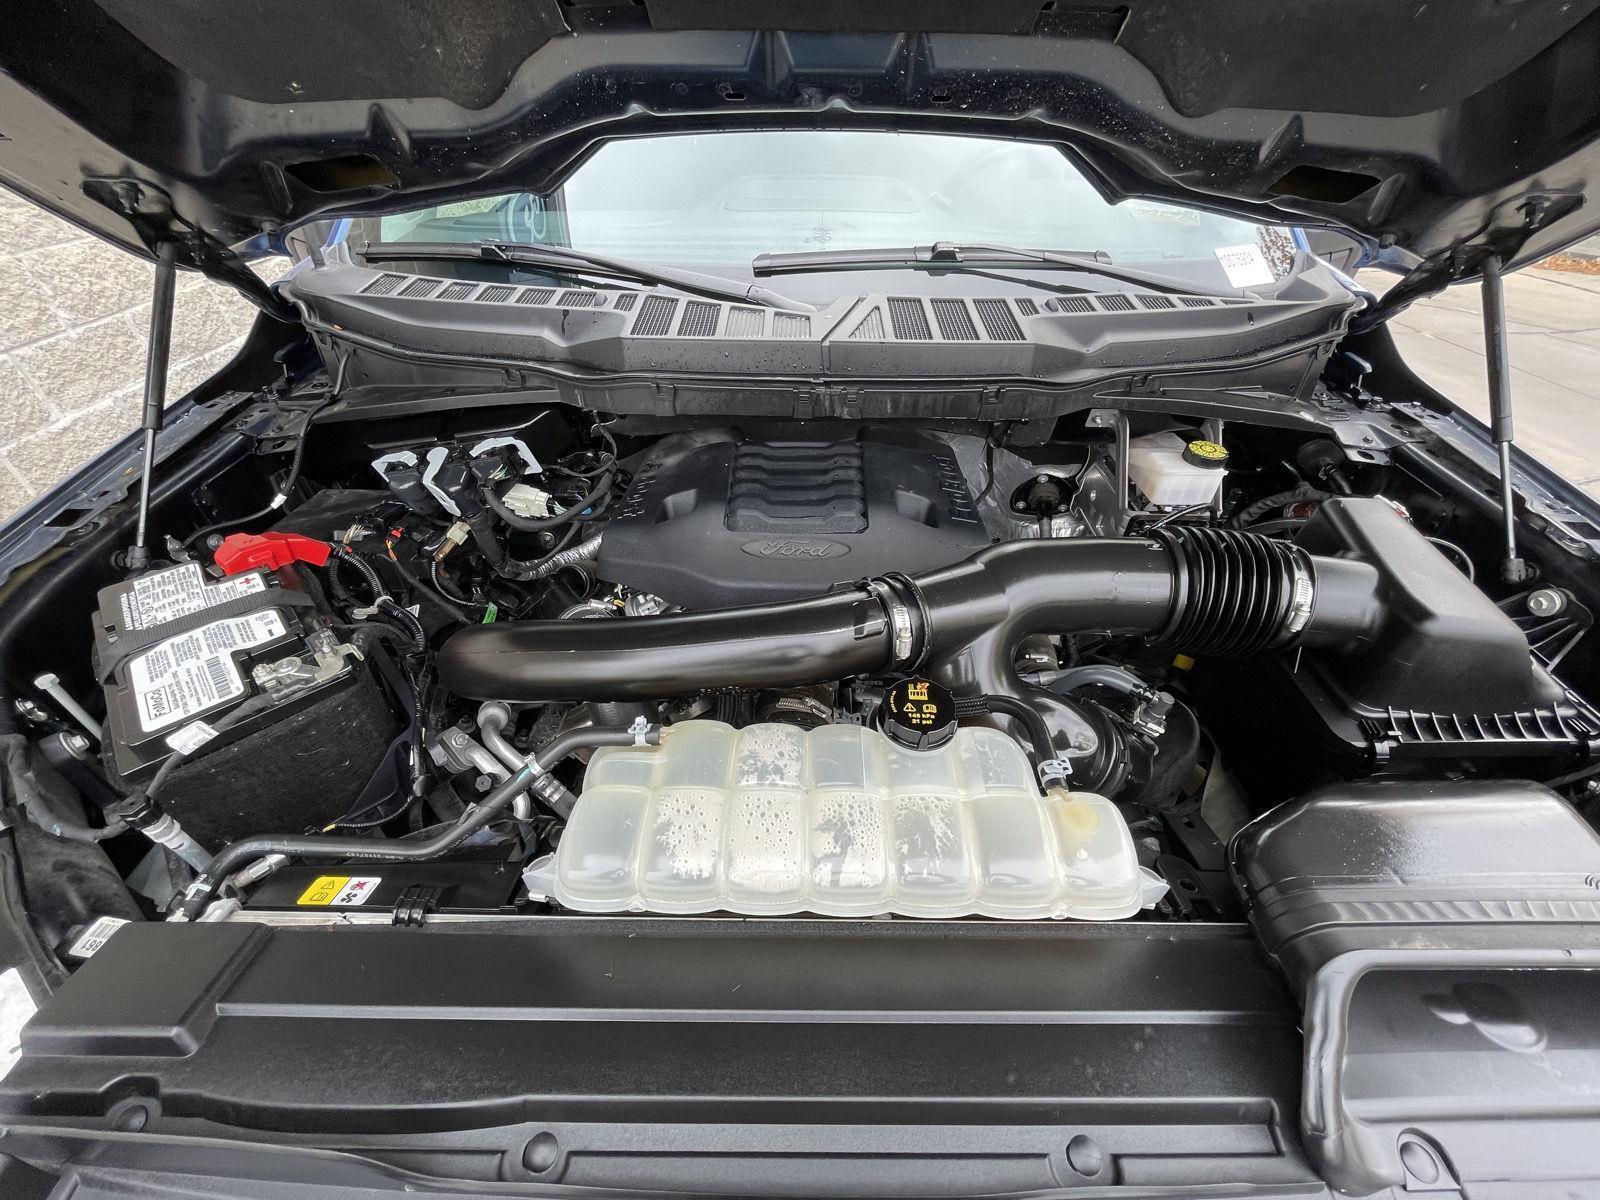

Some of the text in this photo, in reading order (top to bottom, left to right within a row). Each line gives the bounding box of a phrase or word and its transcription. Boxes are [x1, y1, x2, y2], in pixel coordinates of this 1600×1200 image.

[760, 539, 833, 557] Ford
[149, 688, 166, 718] FoMoCo
[80, 939, 103, 952] 861
